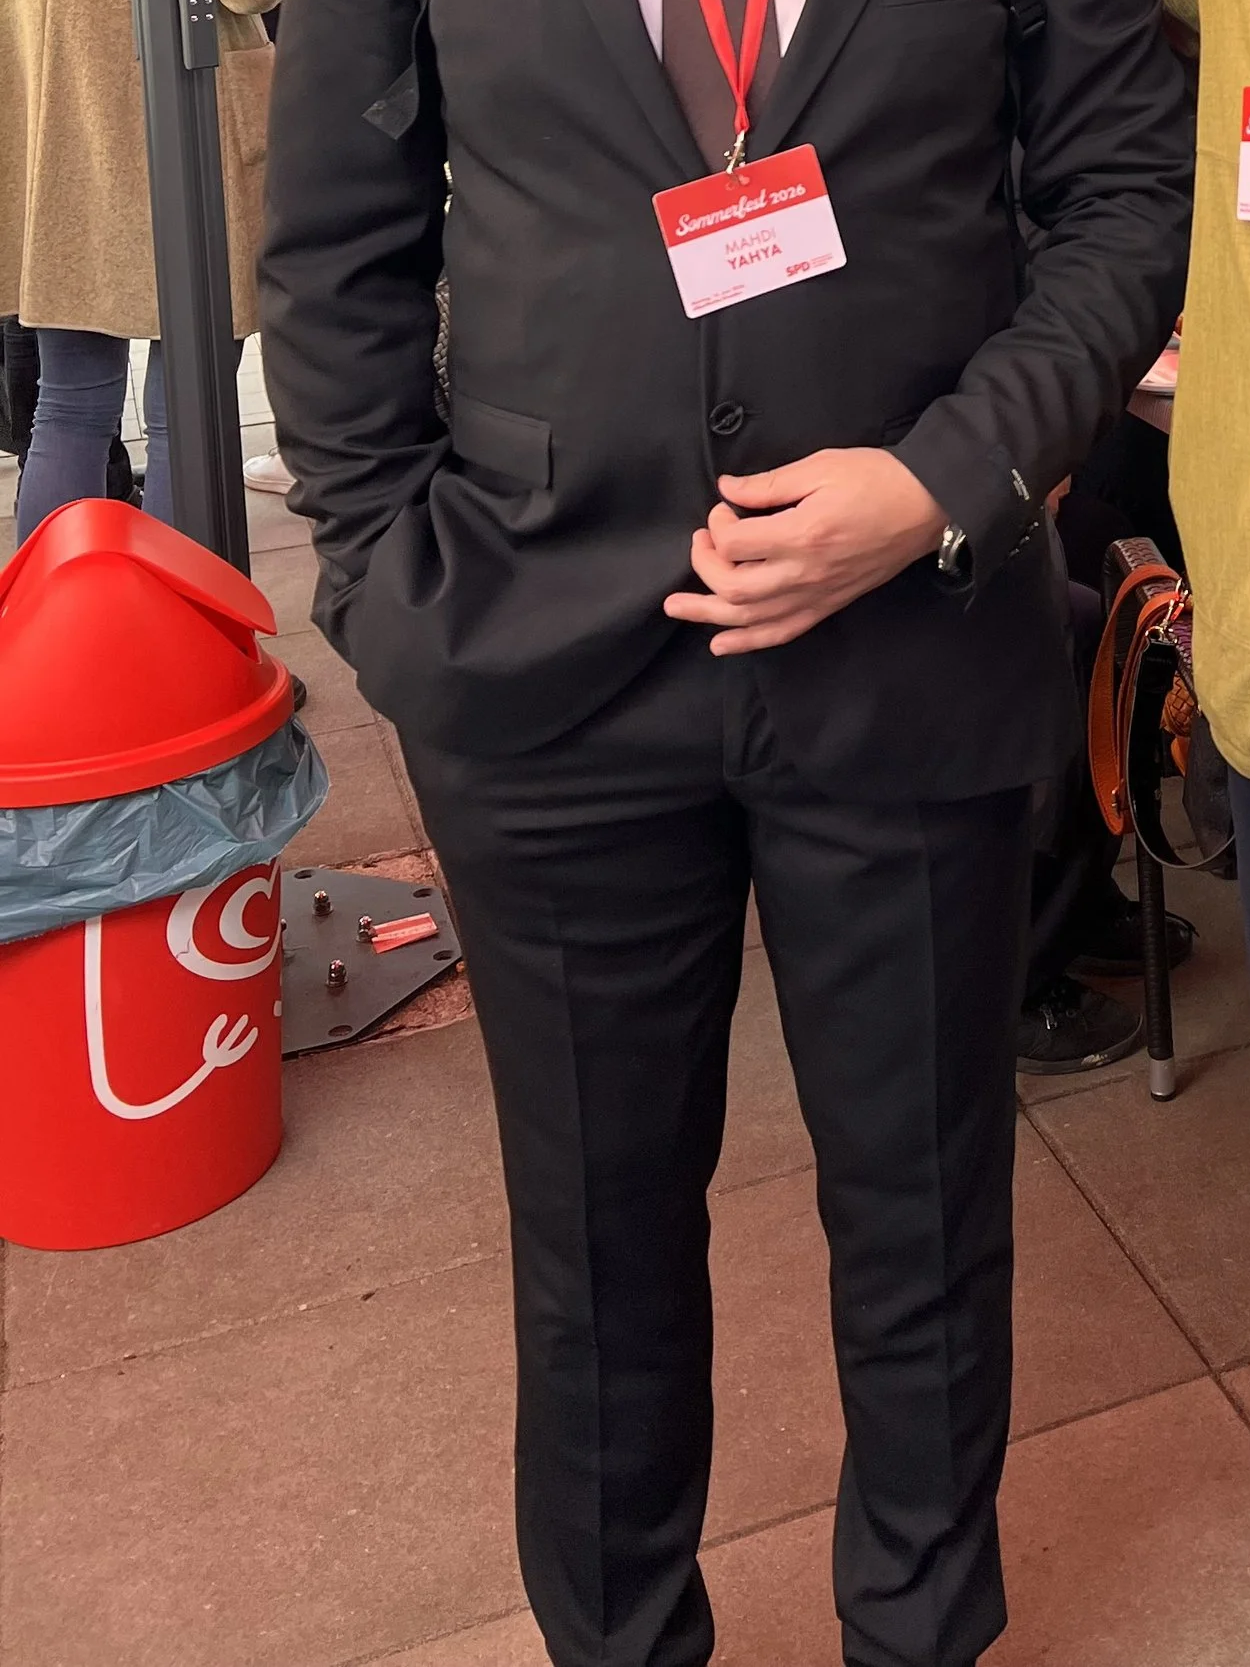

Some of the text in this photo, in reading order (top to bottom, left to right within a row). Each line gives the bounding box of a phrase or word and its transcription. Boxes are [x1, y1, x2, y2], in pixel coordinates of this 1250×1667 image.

[675, 184, 806, 237] Sommerfest 2026
[725, 228, 777, 254] MAHDI
[727, 244, 782, 270] YAHYA
[786, 261, 810, 277] SPD
